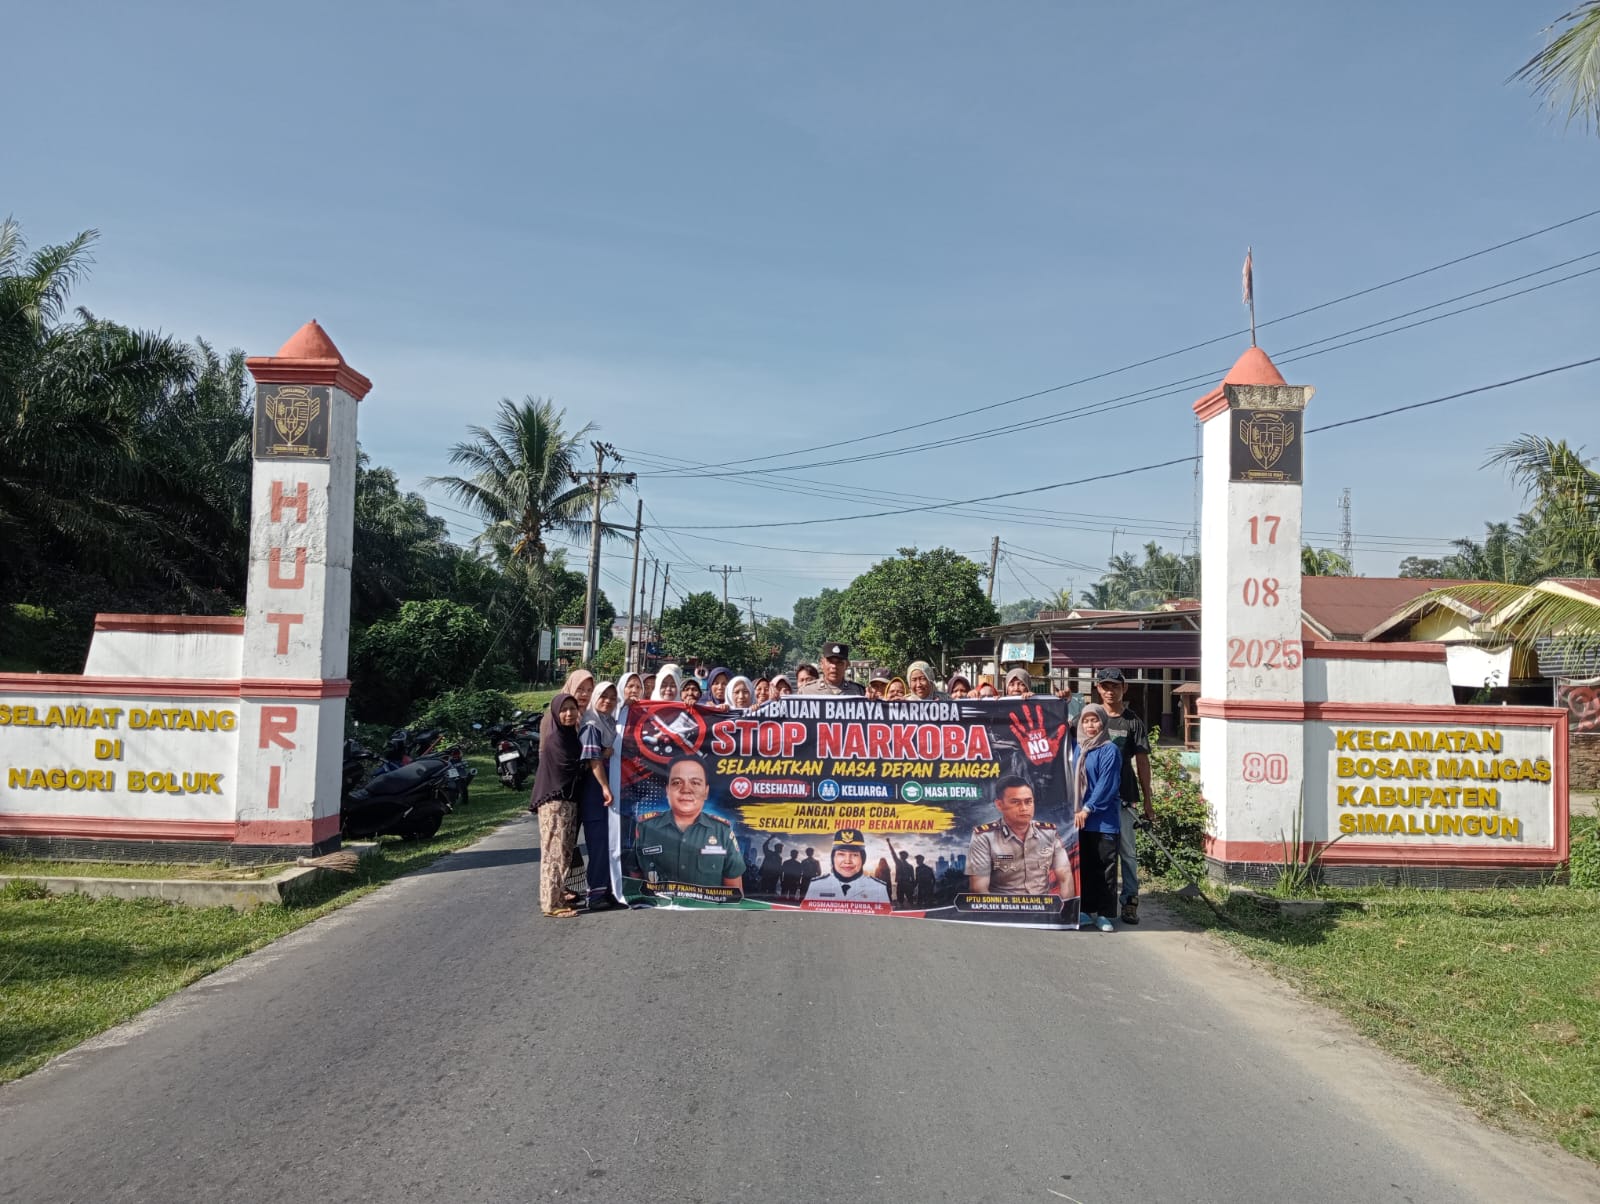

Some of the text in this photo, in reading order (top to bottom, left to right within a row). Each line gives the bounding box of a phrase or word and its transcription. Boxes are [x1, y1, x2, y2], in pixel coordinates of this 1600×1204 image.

[1248, 515, 1281, 544] 17
[1243, 577, 1280, 607] 08
[1228, 639, 1302, 670] 2025
[0, 705, 236, 730] SELAMAT DATANG
[825, 701, 884, 720] BAHAYA
[889, 703, 960, 721] NARKOBA
[94, 739, 121, 760] DI
[711, 720, 993, 761] STOP NARKOBA
[1027, 738, 1050, 755] NO
[1336, 730, 1502, 752] KECAMATAN
[716, 759, 1000, 779] SELAMATKAN MASA DEPAN BANGSA
[1242, 752, 1288, 784] 80
[1336, 757, 1552, 782] BOSAR MALIGAS
[8, 768, 222, 793] NAGORI BOLUK
[841, 784, 888, 797] KELUARGA
[924, 786, 978, 799] MASA DEPAN
[1336, 785, 1498, 808] KABUPATEN
[794, 805, 899, 819] JANGAN COBA COBA,
[759, 817, 934, 831] SEKALI PAKAI, HIDUP BERANTAKAN
[1339, 813, 1519, 838] SIMALUNGUN
